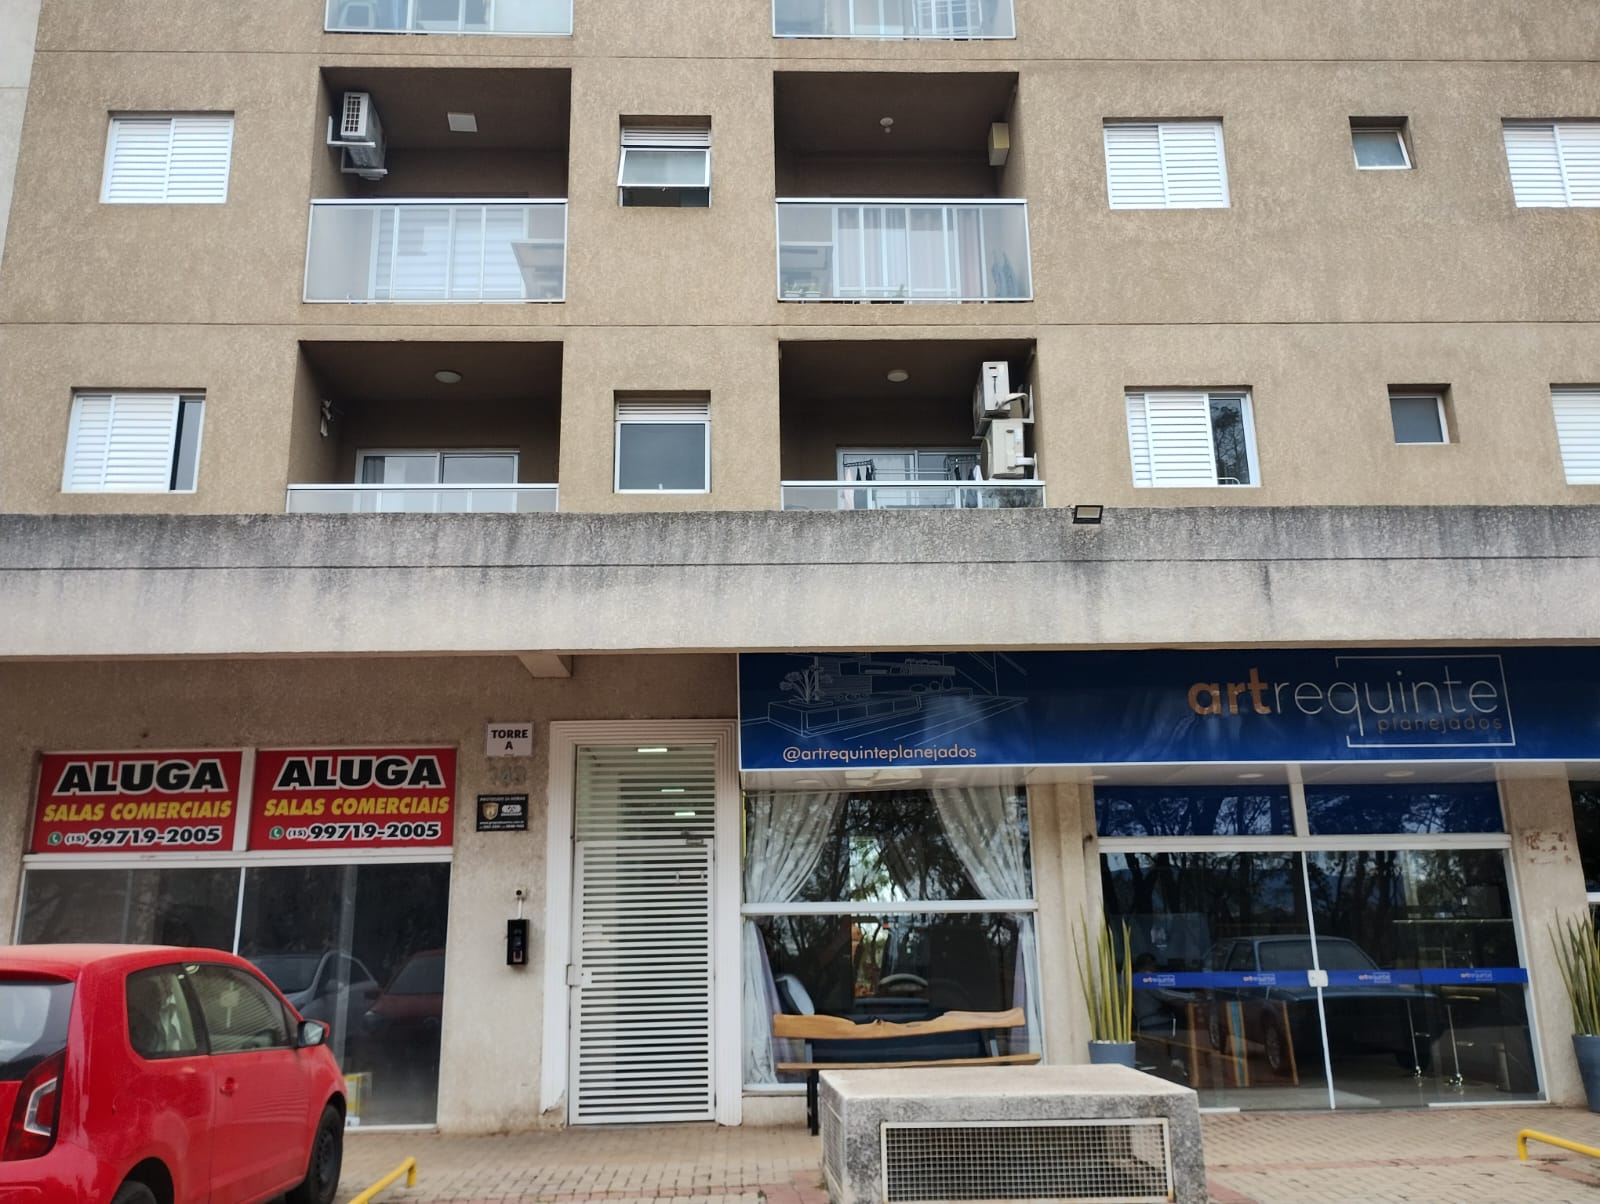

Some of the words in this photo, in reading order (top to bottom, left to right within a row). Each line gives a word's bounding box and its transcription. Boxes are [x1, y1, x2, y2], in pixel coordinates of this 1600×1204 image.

[491, 729, 528, 739] TORRE
[1378, 715, 1502, 734] planejados
[505, 741, 513, 750] A
[783, 744, 977, 763] @artrequinteplanejados
[54, 760, 227, 795] ALUGA
[274, 756, 445, 789] ALUGA
[43, 803, 105, 822] SALAS
[110, 800, 232, 820] COMERCIAIS
[264, 798, 326, 816] SALAS
[331, 796, 449, 815] COMERCIAIS
[88, 827, 221, 846] 99719-2005
[309, 822, 441, 841] 99719-2005
